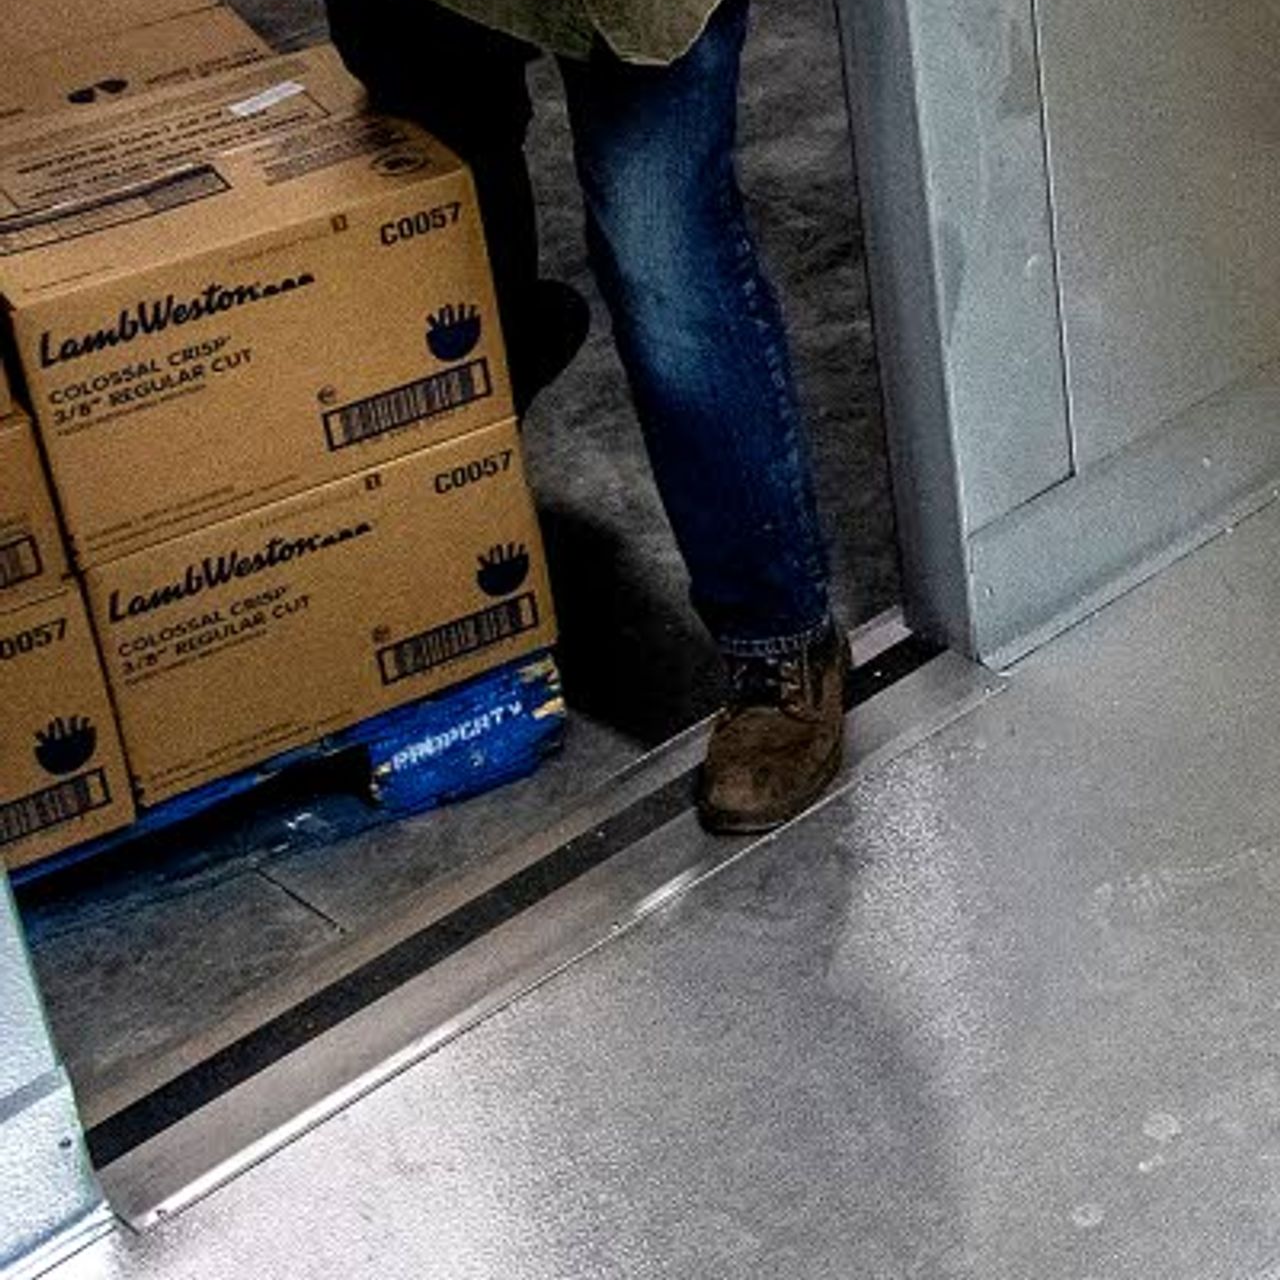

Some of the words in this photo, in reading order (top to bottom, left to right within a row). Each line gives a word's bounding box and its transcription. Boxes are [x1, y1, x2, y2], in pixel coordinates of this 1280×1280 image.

[380, 201, 462, 247] C0057
[49, 358, 163, 406] COLOSSAL
[167, 336, 226, 367] CRISP
[108, 365, 206, 407] REGULAR
[211, 348, 253, 373] CUT
[433, 449, 513, 494] C0057
[118, 609, 224, 657] COLOSSAL
[229, 585, 288, 616] CRISP
[175, 612, 267, 656] REGULAR
[272, 594, 312, 619] CUT
